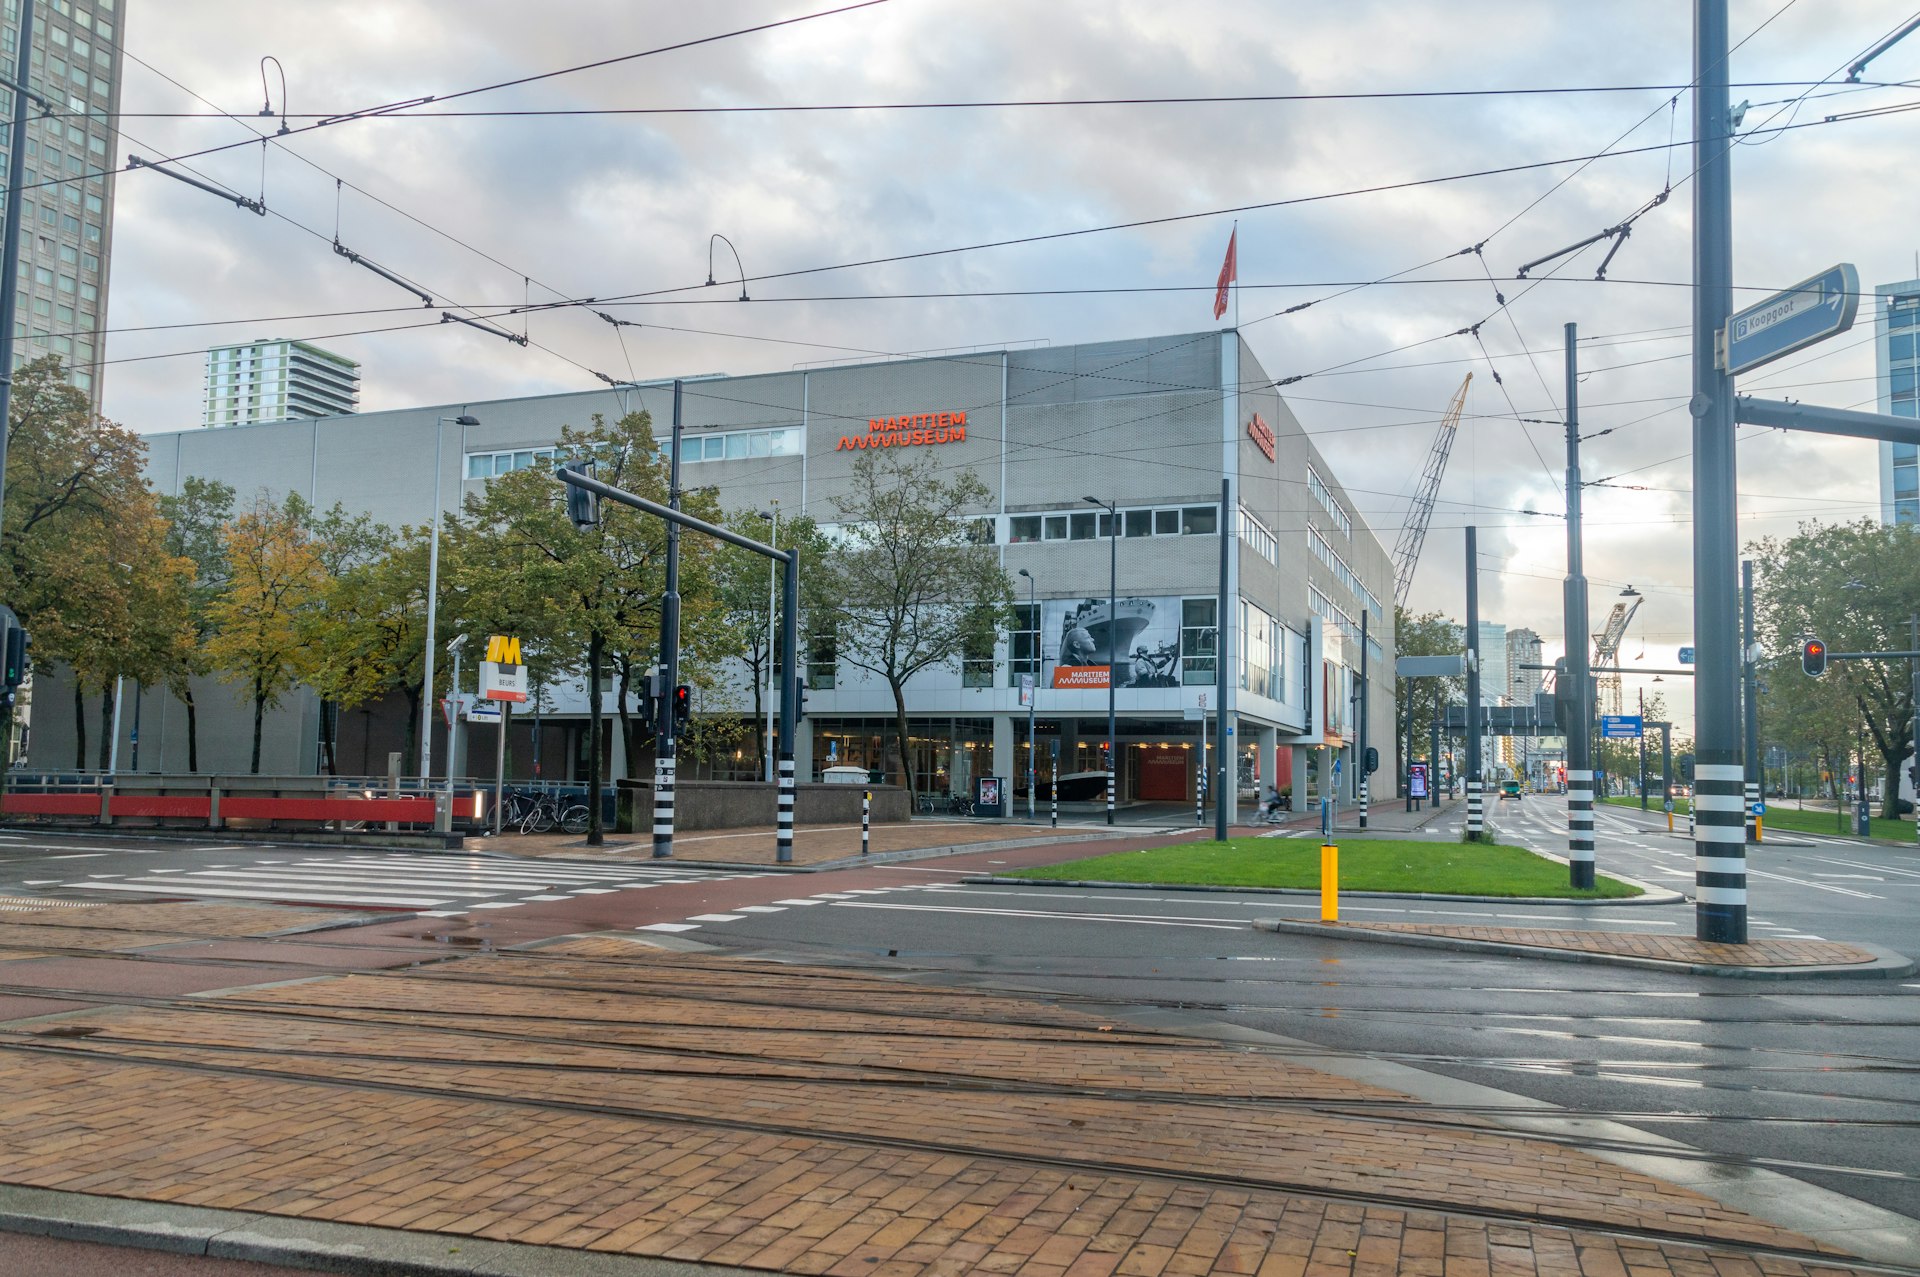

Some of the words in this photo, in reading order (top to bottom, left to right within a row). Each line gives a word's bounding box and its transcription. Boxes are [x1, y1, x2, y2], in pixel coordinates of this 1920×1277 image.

[1749, 299, 1795, 330] Koopgoot
[868, 411, 966, 433] MARITIEM
[498, 679, 516, 688] BEURS
